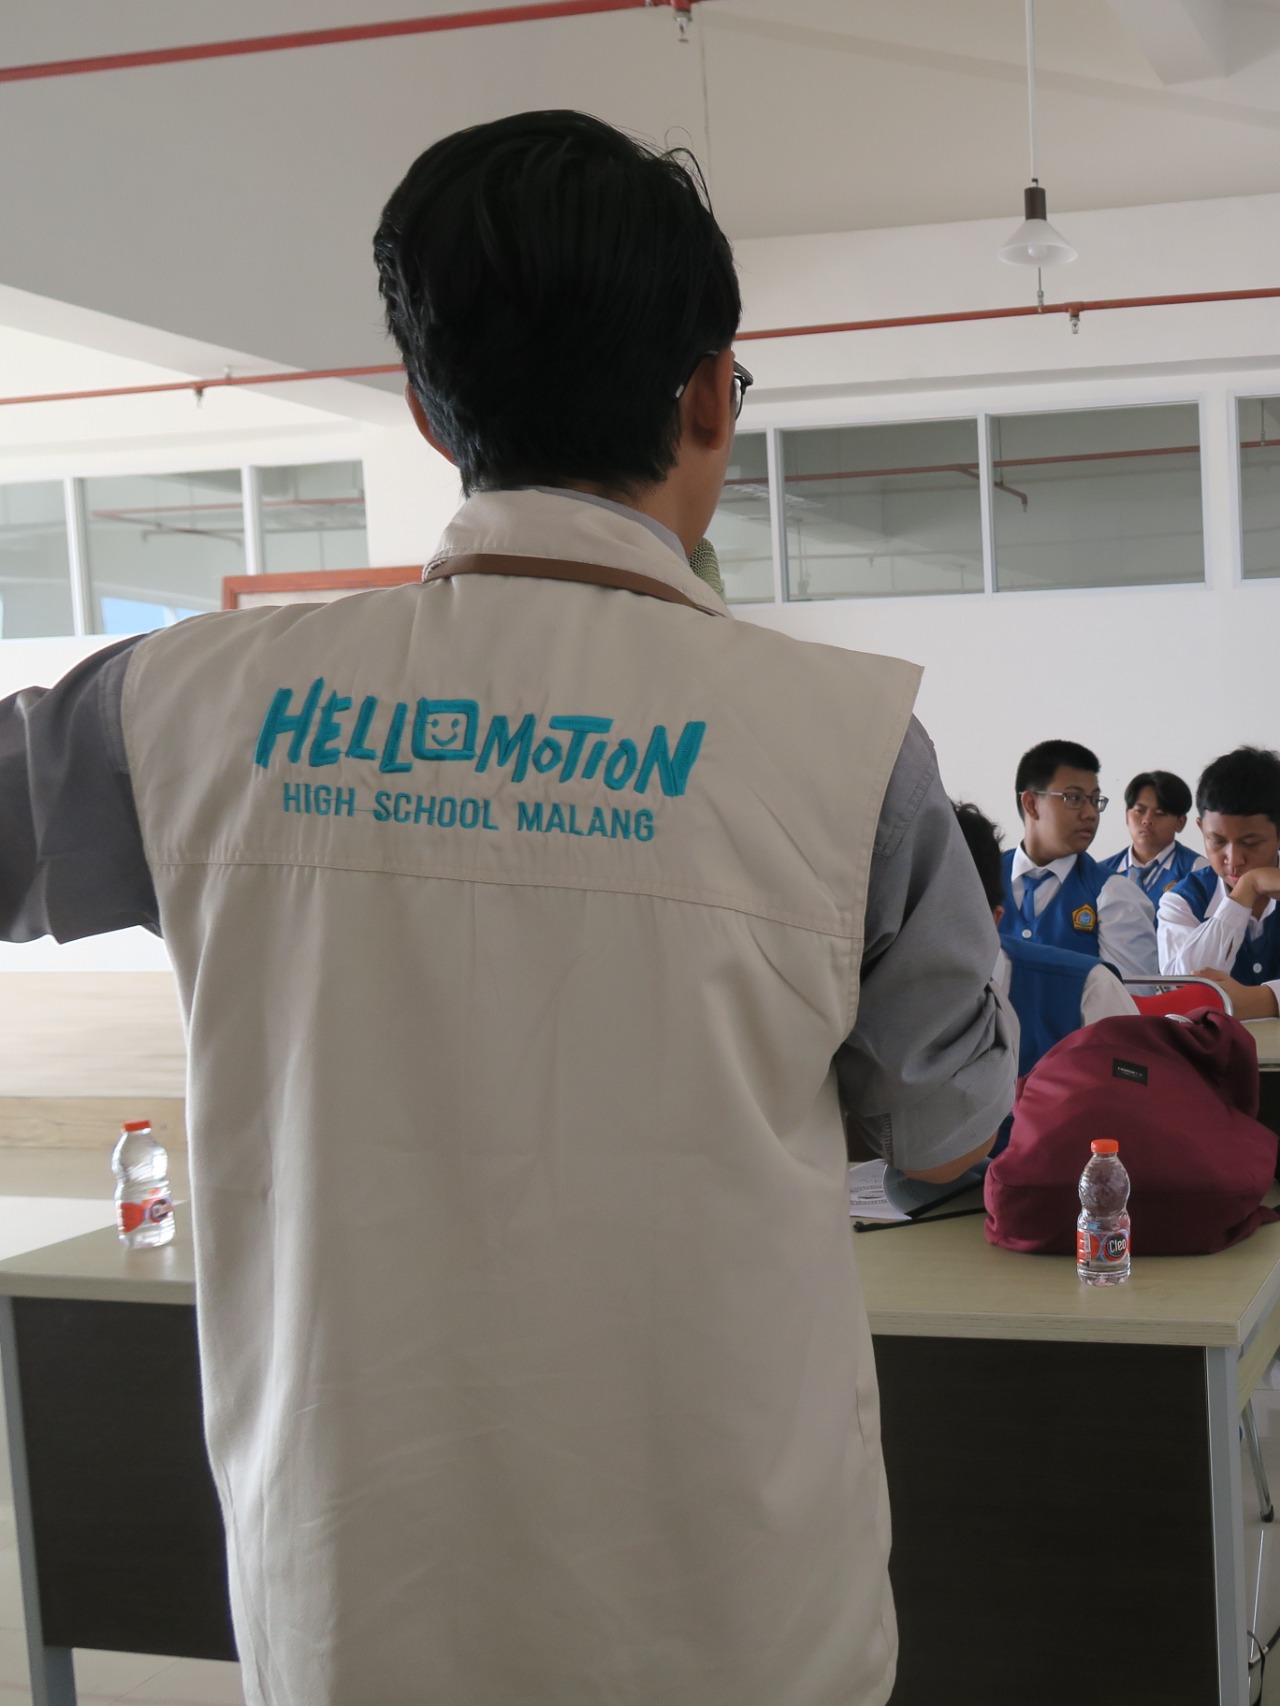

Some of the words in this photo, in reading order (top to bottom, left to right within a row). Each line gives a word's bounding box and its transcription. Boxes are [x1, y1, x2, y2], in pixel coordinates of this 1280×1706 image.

[283, 783, 355, 816] HIGH
[373, 790, 499, 831] SCHOOL
[518, 801, 654, 841] MALANG
[1109, 1238, 1127, 1253] Cleo
